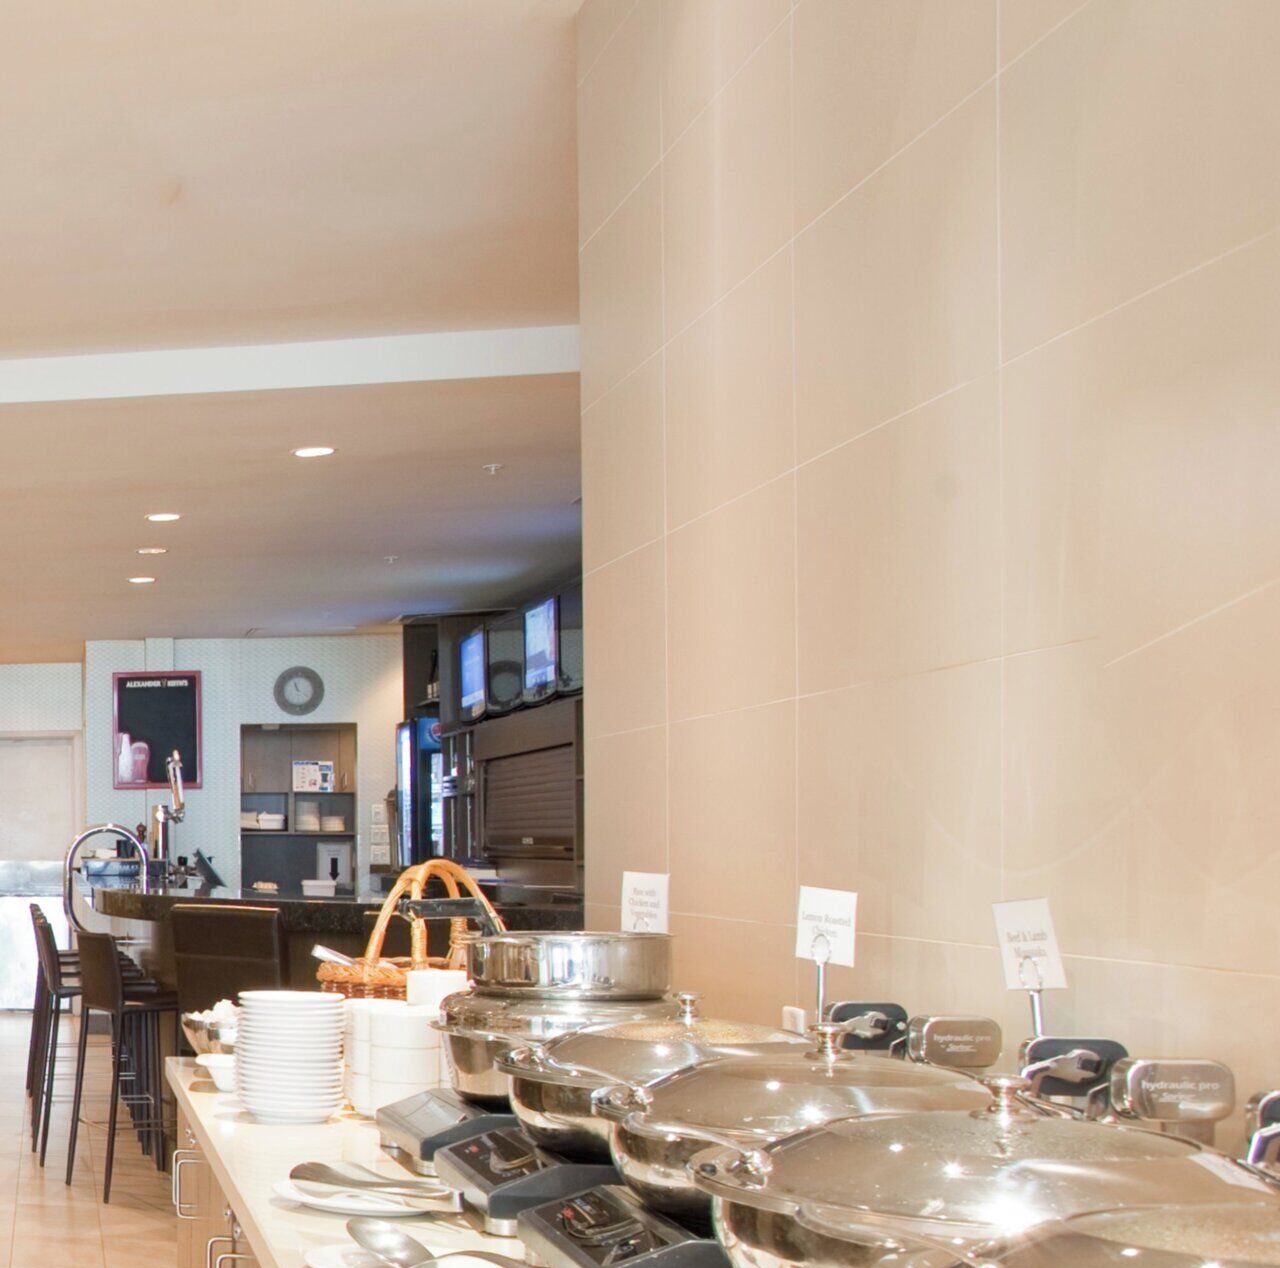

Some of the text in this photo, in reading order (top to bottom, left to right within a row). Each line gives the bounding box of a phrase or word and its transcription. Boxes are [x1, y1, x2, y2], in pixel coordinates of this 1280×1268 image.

[126, 680, 161, 688] ALEXANDER
[802, 911, 851, 927] Lemon Roasted
[1007, 928, 1048, 943] Beef & Lamb
[933, 1033, 973, 1043] hydraulic
[1141, 1080, 1220, 1092] hydraulic pro
